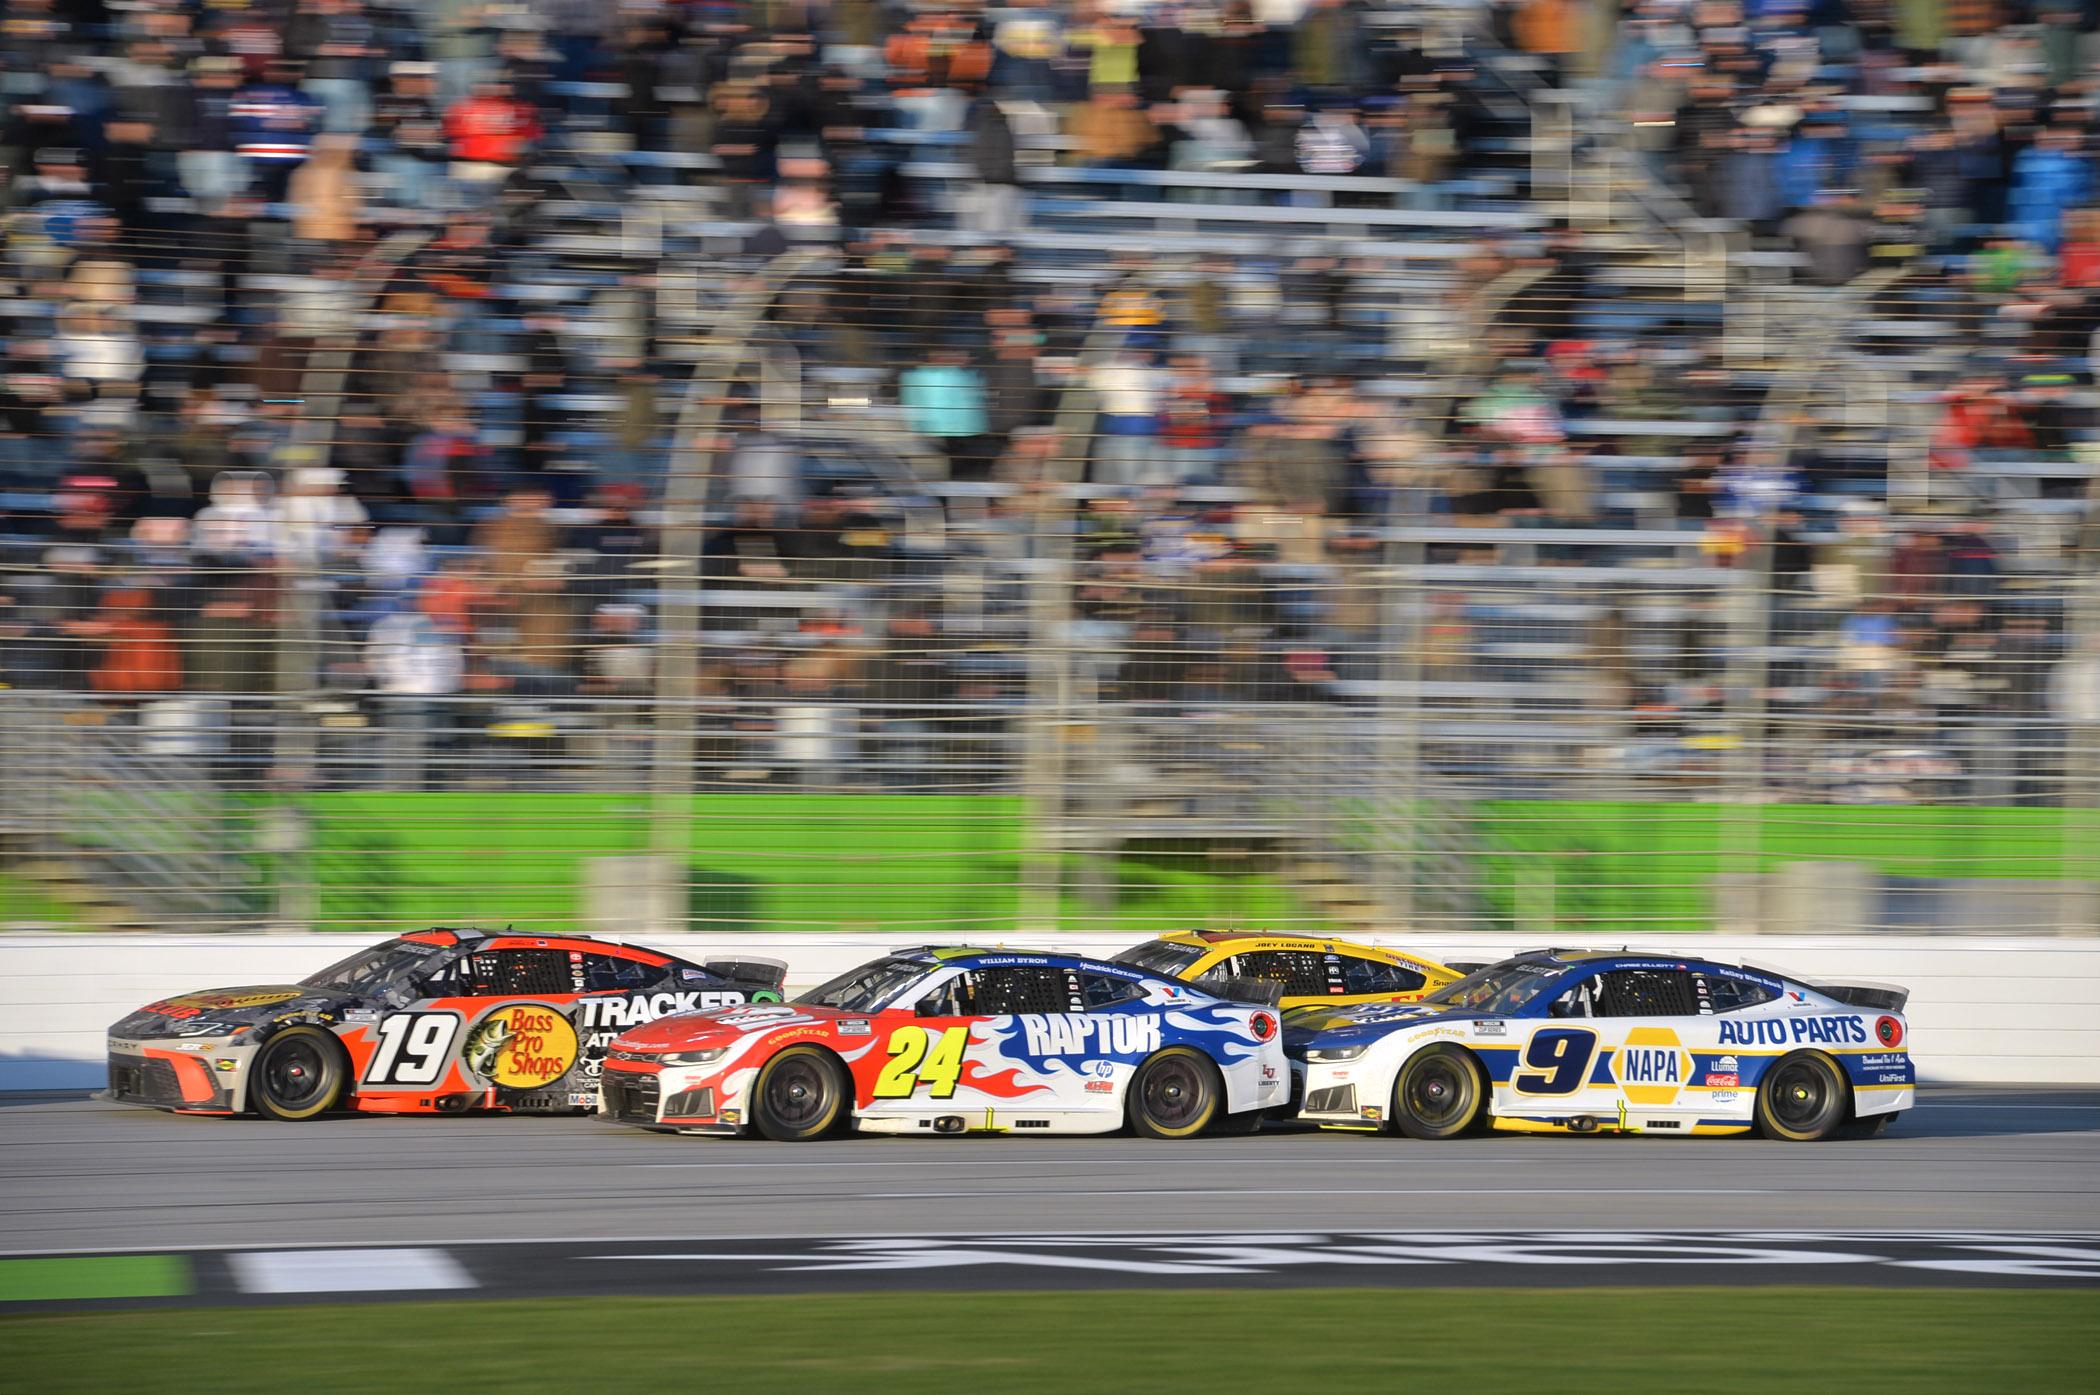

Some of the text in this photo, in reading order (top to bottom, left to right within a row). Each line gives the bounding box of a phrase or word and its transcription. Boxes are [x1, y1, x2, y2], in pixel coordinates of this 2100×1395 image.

[1385, 953, 1432, 971] DISCOUNT
[1745, 974, 1762, 985] Blue
[1763, 979, 1782, 989] Book
[510, 1009, 552, 1032] Bass
[1718, 1016, 1866, 1045] AUTO PARTS
[511, 1031, 543, 1053] Pro
[769, 1027, 829, 1044] GOODYEAR
[1019, 1013, 1161, 1056] RAPTOR
[1408, 1027, 1466, 1043] GOODYEAR
[367, 1014, 459, 1084] 19
[508, 1051, 563, 1080] Shops
[872, 1025, 969, 1098] 24
[1098, 1061, 1112, 1078] hp
[1515, 1027, 1598, 1095] 9
[1625, 1049, 1679, 1082] NAPA
[1707, 1075, 1737, 1086] Coca-Cola
[1879, 1073, 1905, 1082] UniFirst
[571, 1095, 598, 1105] Mobil
[1712, 1089, 1738, 1098] prime
